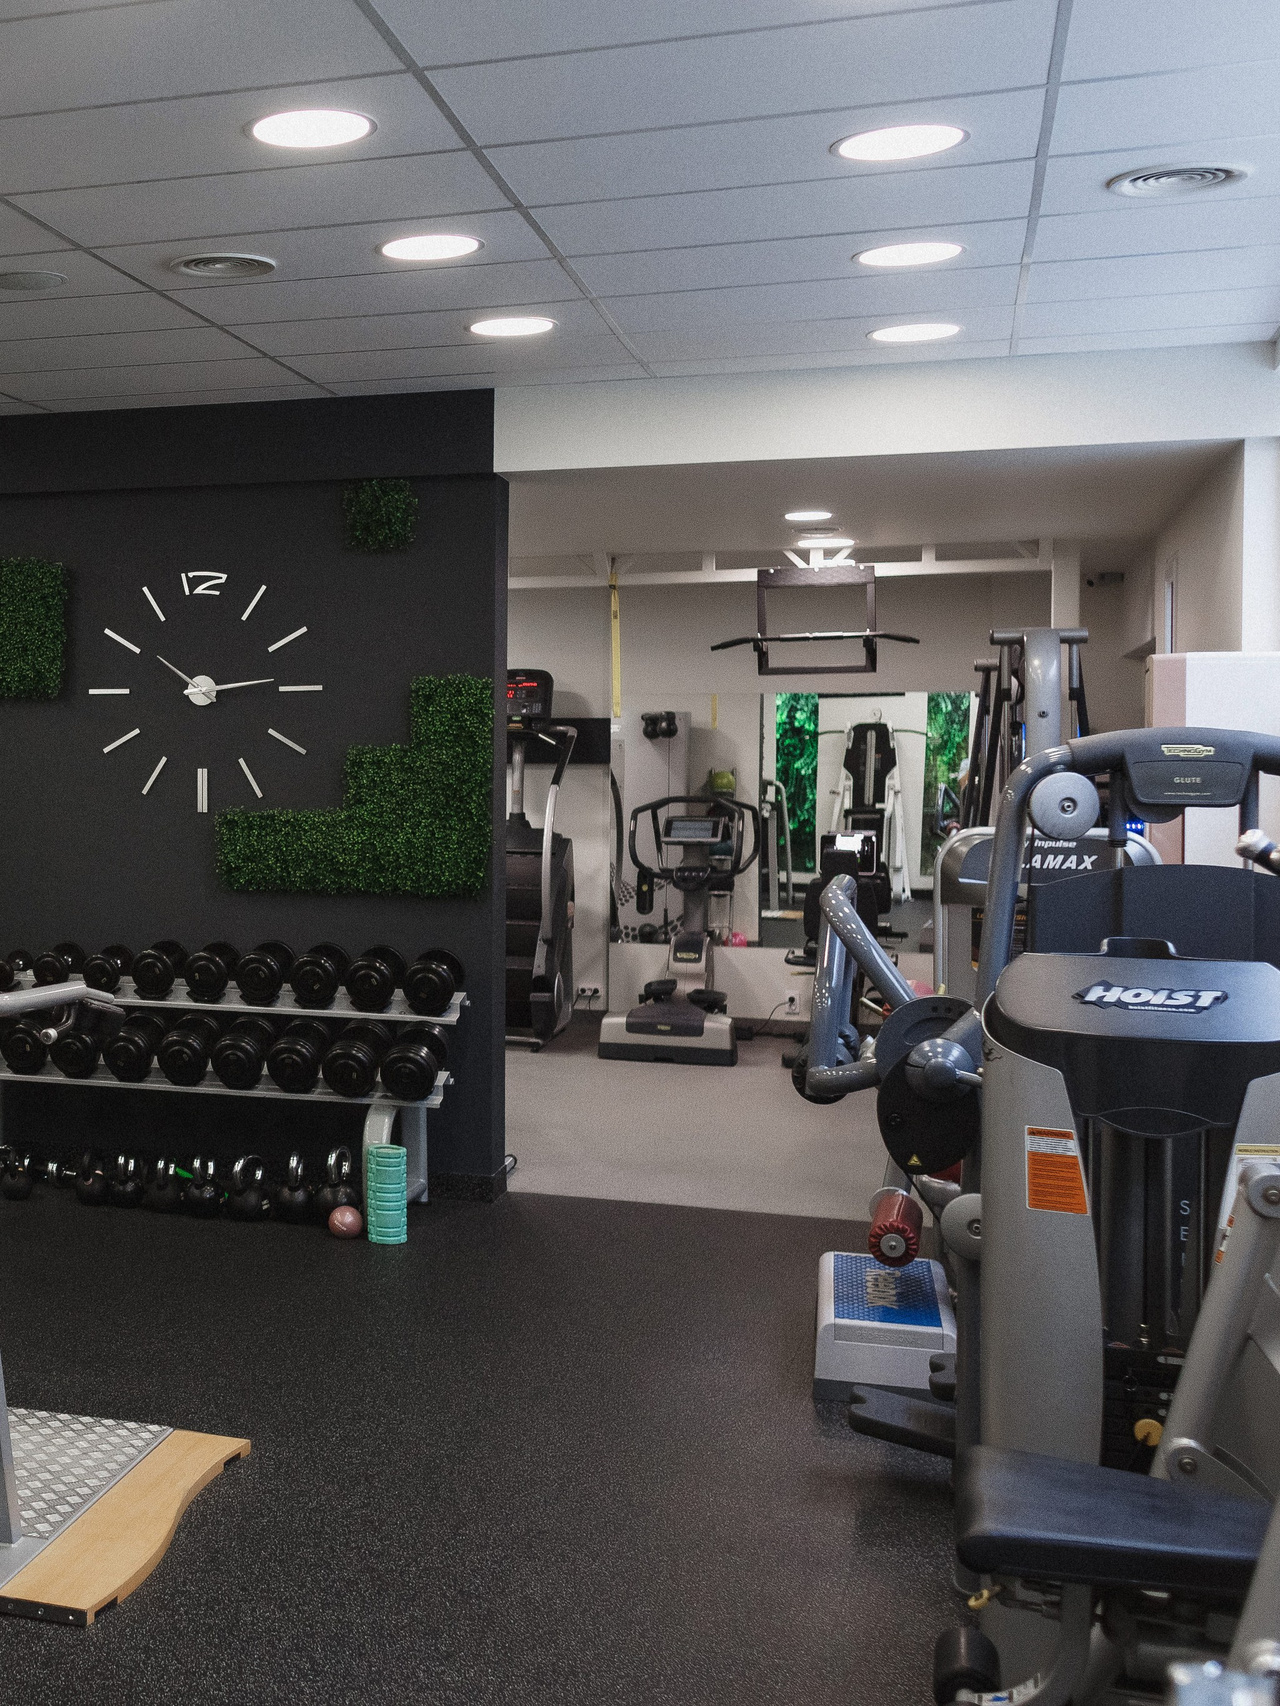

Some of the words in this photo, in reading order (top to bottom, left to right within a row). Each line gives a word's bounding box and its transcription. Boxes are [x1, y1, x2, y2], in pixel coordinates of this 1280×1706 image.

[180, 571, 227, 595] 12
[1173, 776, 1202, 784] GLUTE
[1022, 854, 1099, 870] AMAX
[1084, 985, 1222, 1008] HOIST
